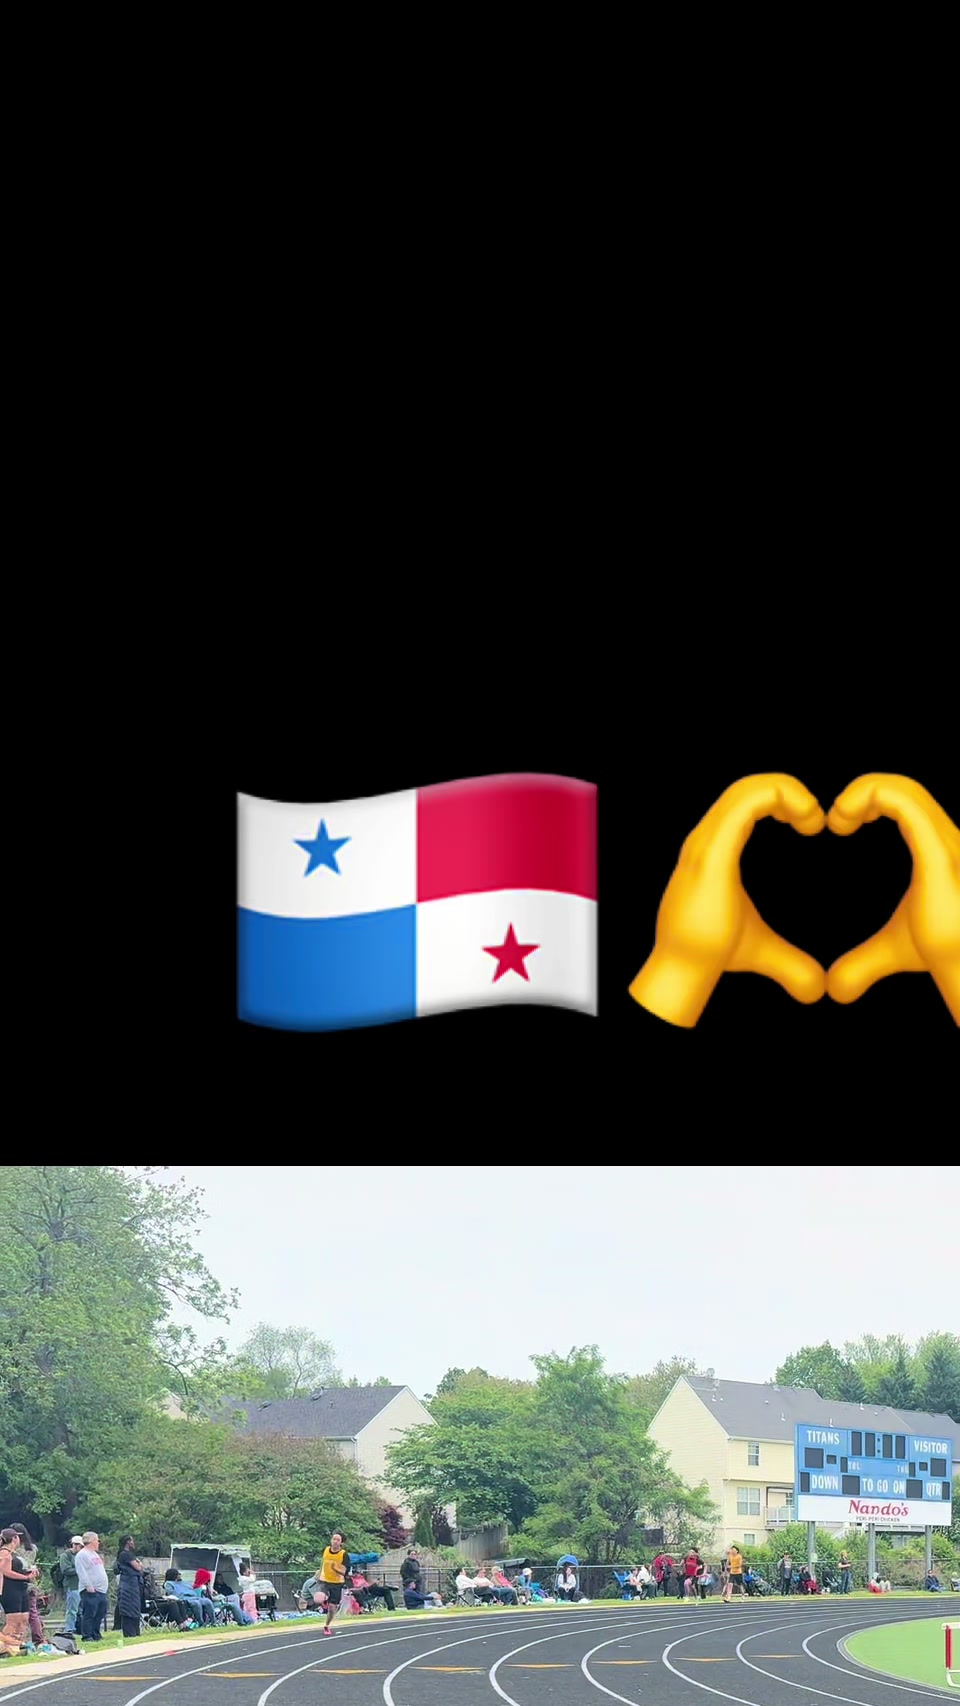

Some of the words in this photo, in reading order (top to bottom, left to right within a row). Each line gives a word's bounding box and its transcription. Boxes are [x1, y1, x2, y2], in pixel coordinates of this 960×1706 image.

[807, 1430, 840, 1445] TITANS
[914, 1439, 948, 1454] VISITOR
[812, 1474, 838, 1490] DOWN
[862, 1478, 874, 1492] TO
[876, 1479, 889, 1493] GO
[893, 1479, 905, 1494] ON
[926, 1482, 942, 1497] QTR
[848, 1499, 909, 1516] Nando's
